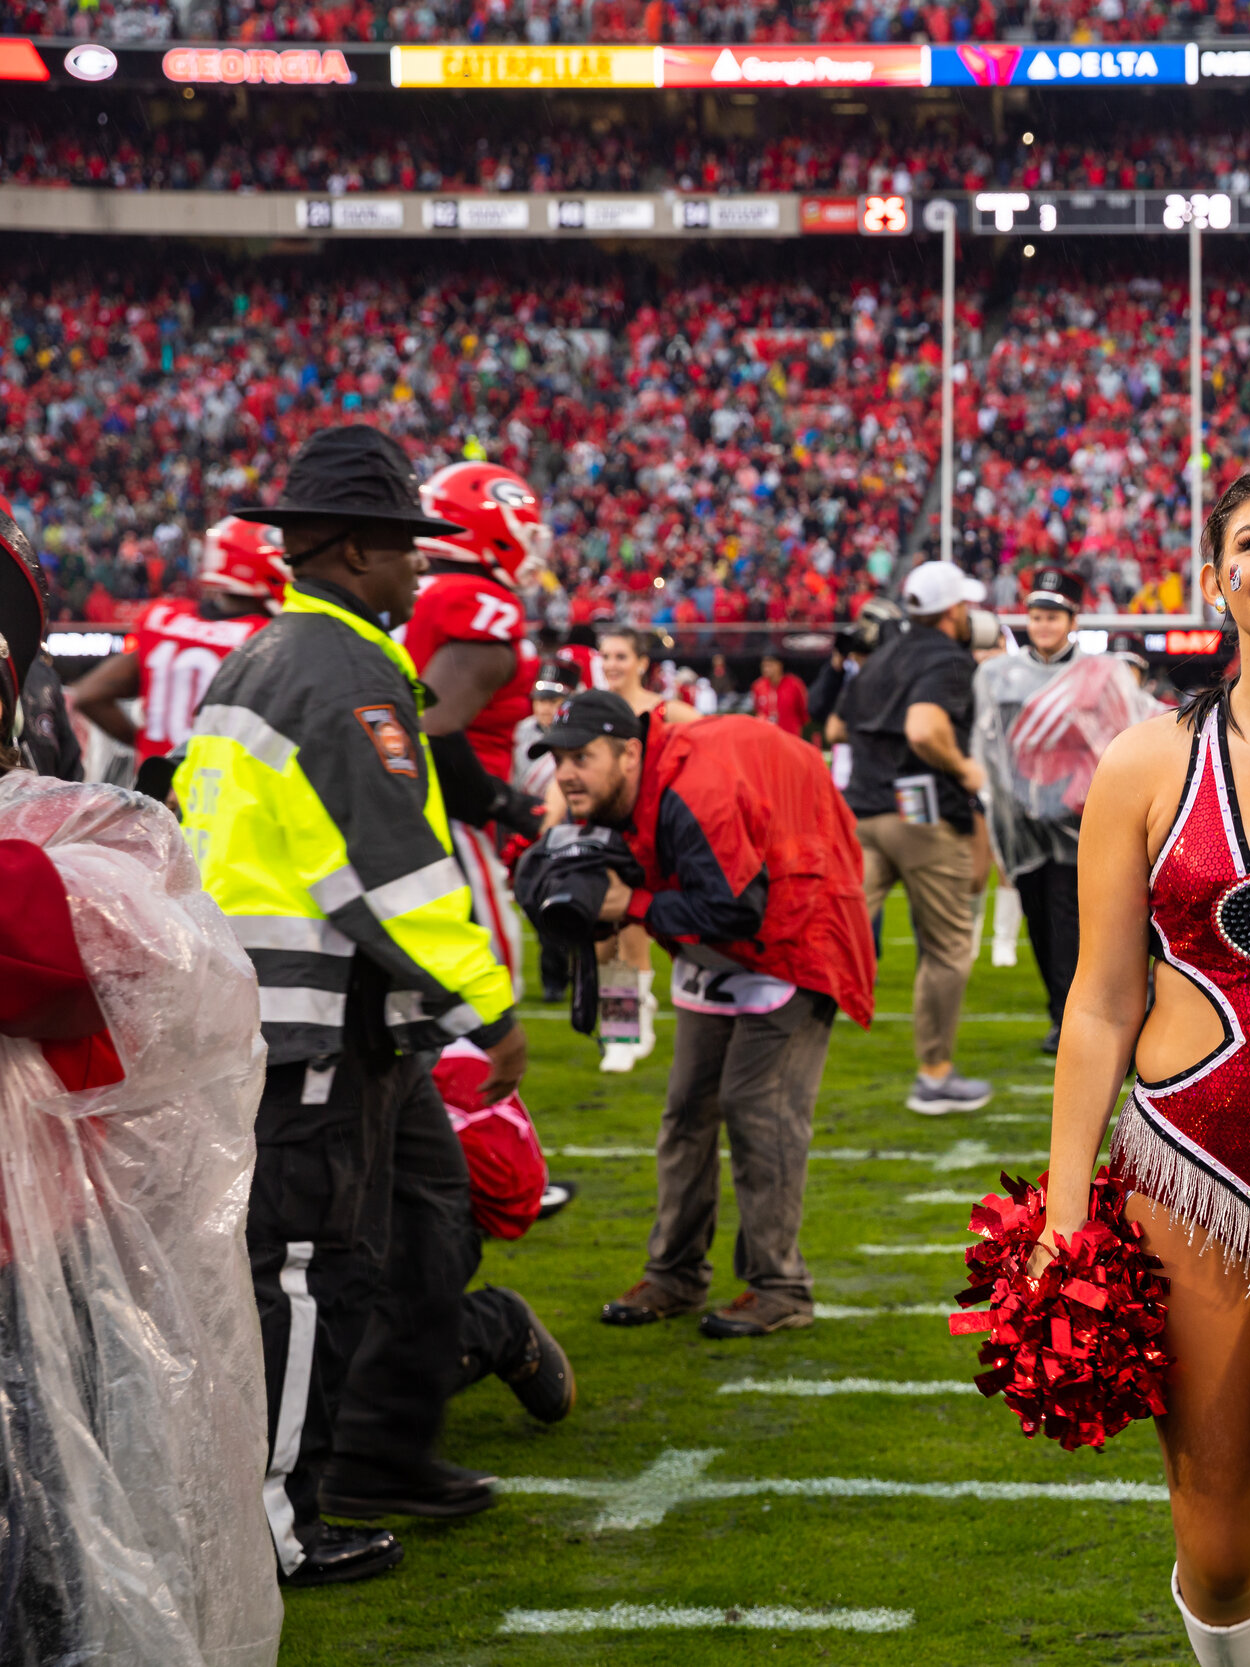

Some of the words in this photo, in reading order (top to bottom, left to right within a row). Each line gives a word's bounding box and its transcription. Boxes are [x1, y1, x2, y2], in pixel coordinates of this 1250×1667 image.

[162, 48, 351, 84] GEORGIA
[1058, 51, 1158, 78] DELTA
[864, 196, 907, 232] 25
[470, 591, 520, 640] 72
[145, 639, 222, 744] 10
